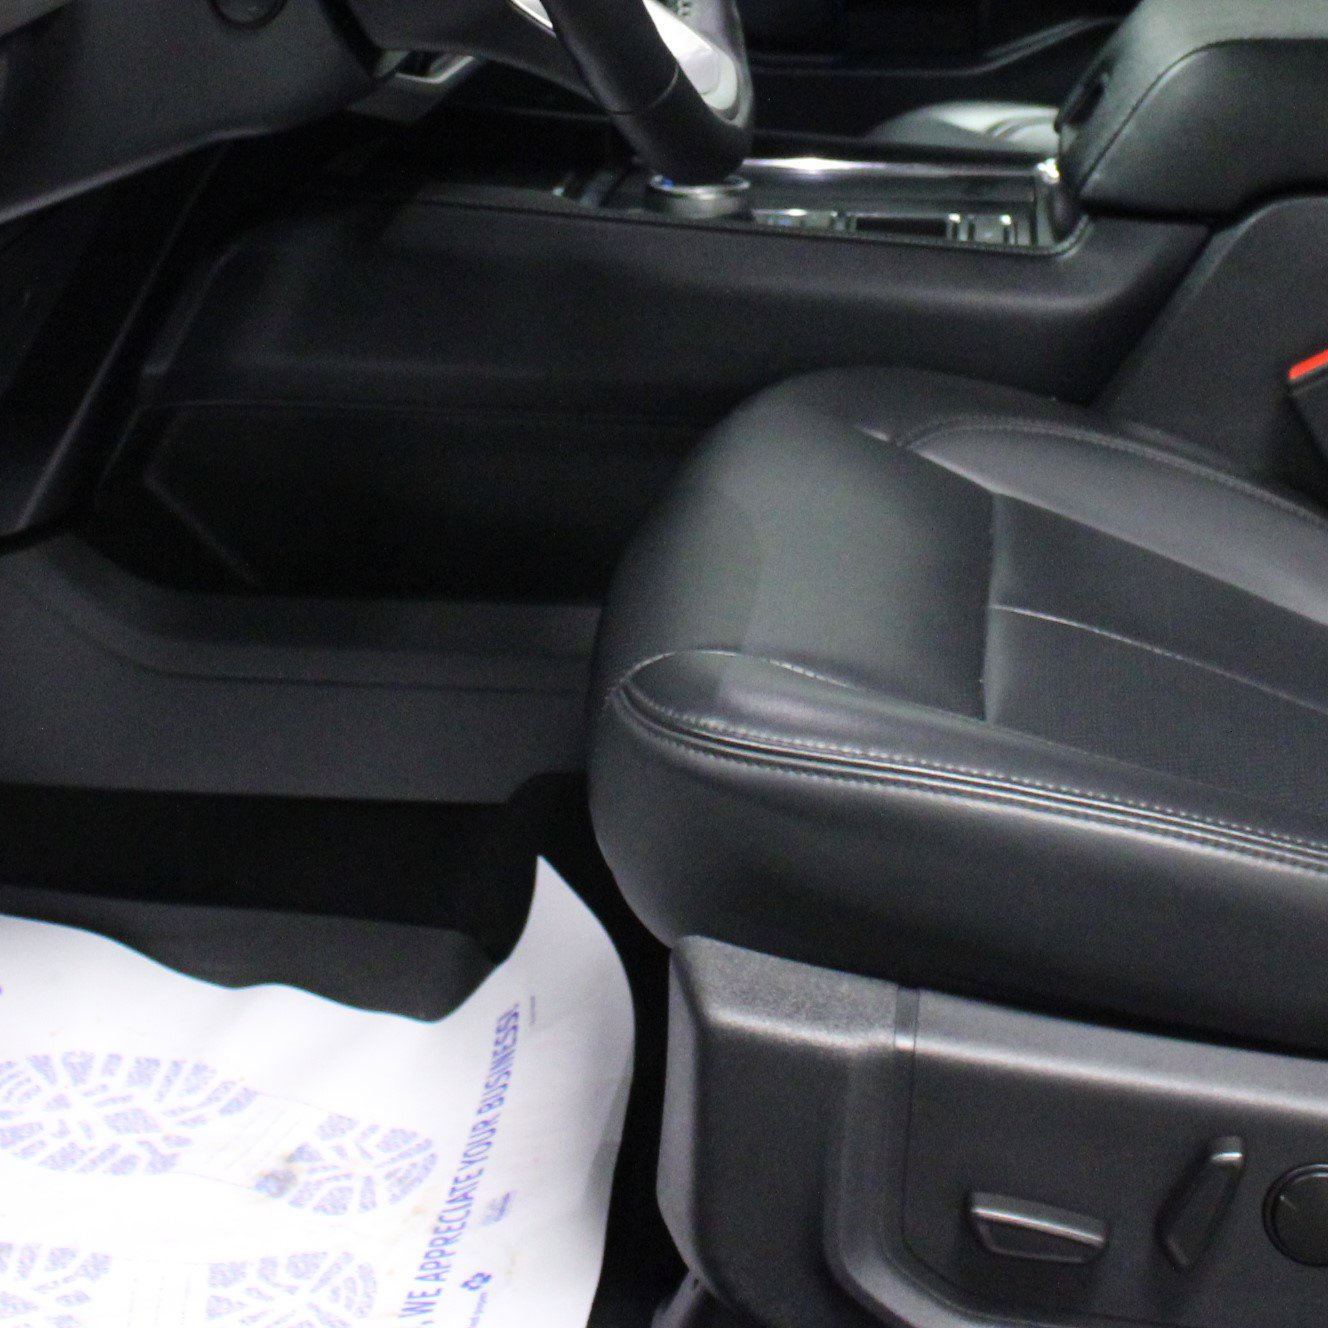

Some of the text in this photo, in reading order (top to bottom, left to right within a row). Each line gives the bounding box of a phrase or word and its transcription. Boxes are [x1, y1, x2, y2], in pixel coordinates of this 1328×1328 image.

[476, 1002, 520, 1116] BUSINESS!
[457, 1112, 501, 1172] YOUR
[414, 1167, 485, 1282] APPRECIATE
[398, 1287, 443, 1318] WE
